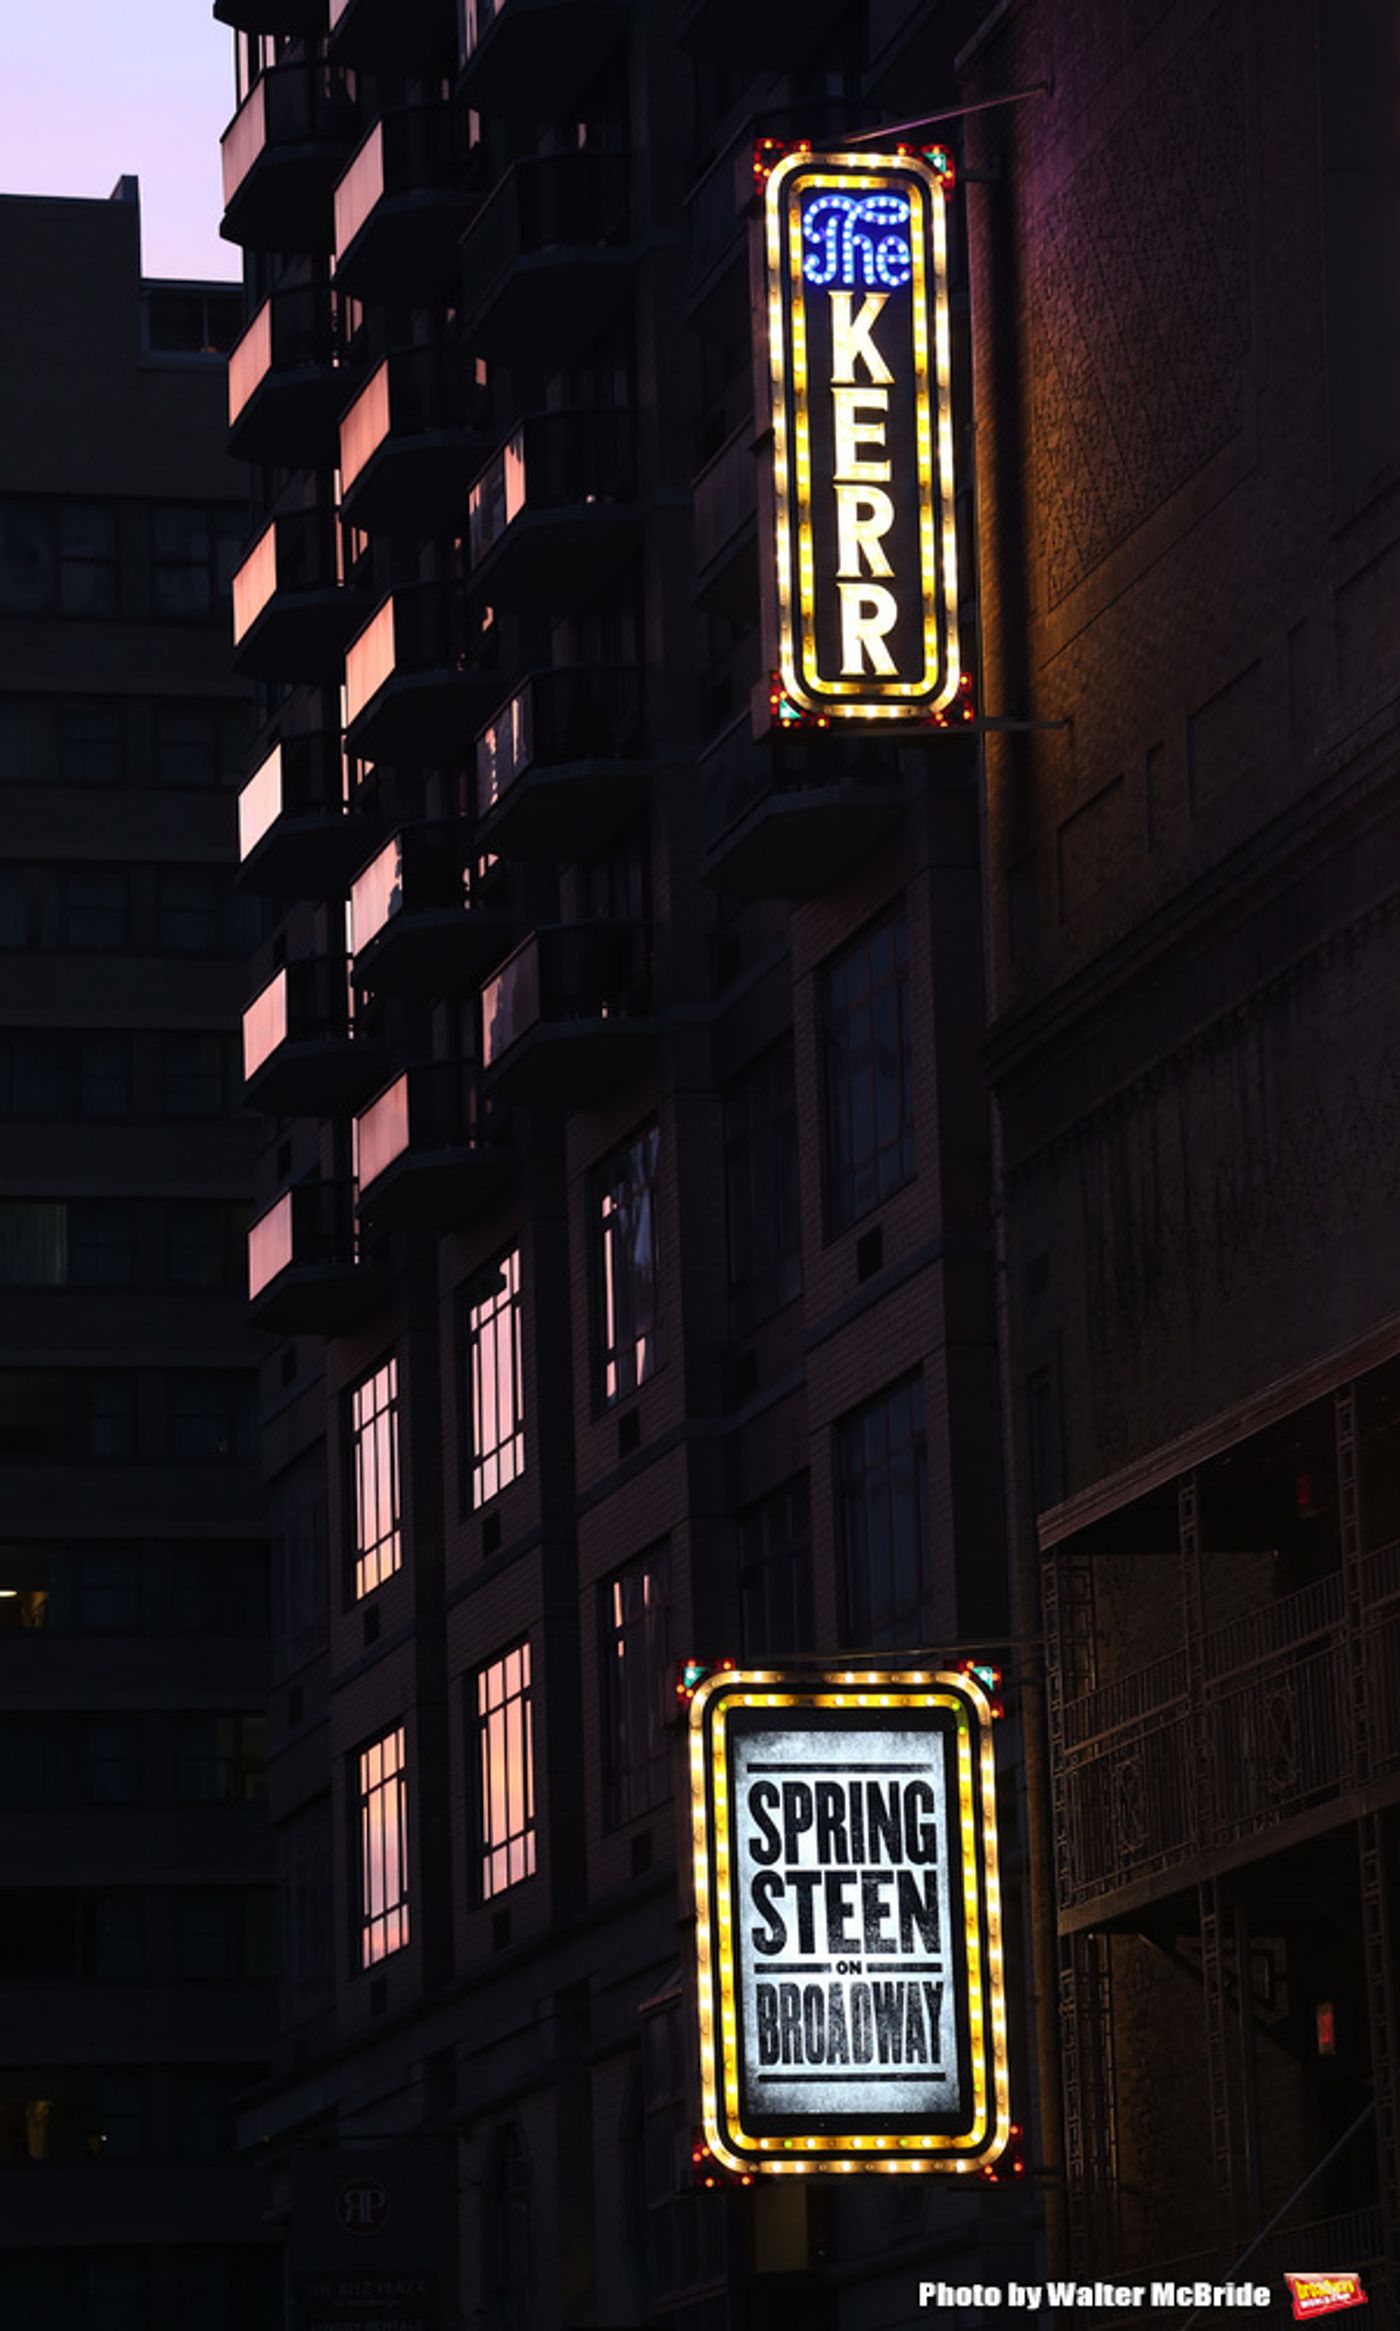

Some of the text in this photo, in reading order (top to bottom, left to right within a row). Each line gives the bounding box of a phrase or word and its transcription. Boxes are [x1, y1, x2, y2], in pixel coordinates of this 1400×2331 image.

[803, 194, 911, 286] The
[828, 290, 900, 676] KERR
[747, 1780, 938, 1866] SPRING
[751, 1869, 942, 1956] STEEN
[836, 1960, 863, 1976] ON
[754, 1980, 944, 2067] BROADWAY
